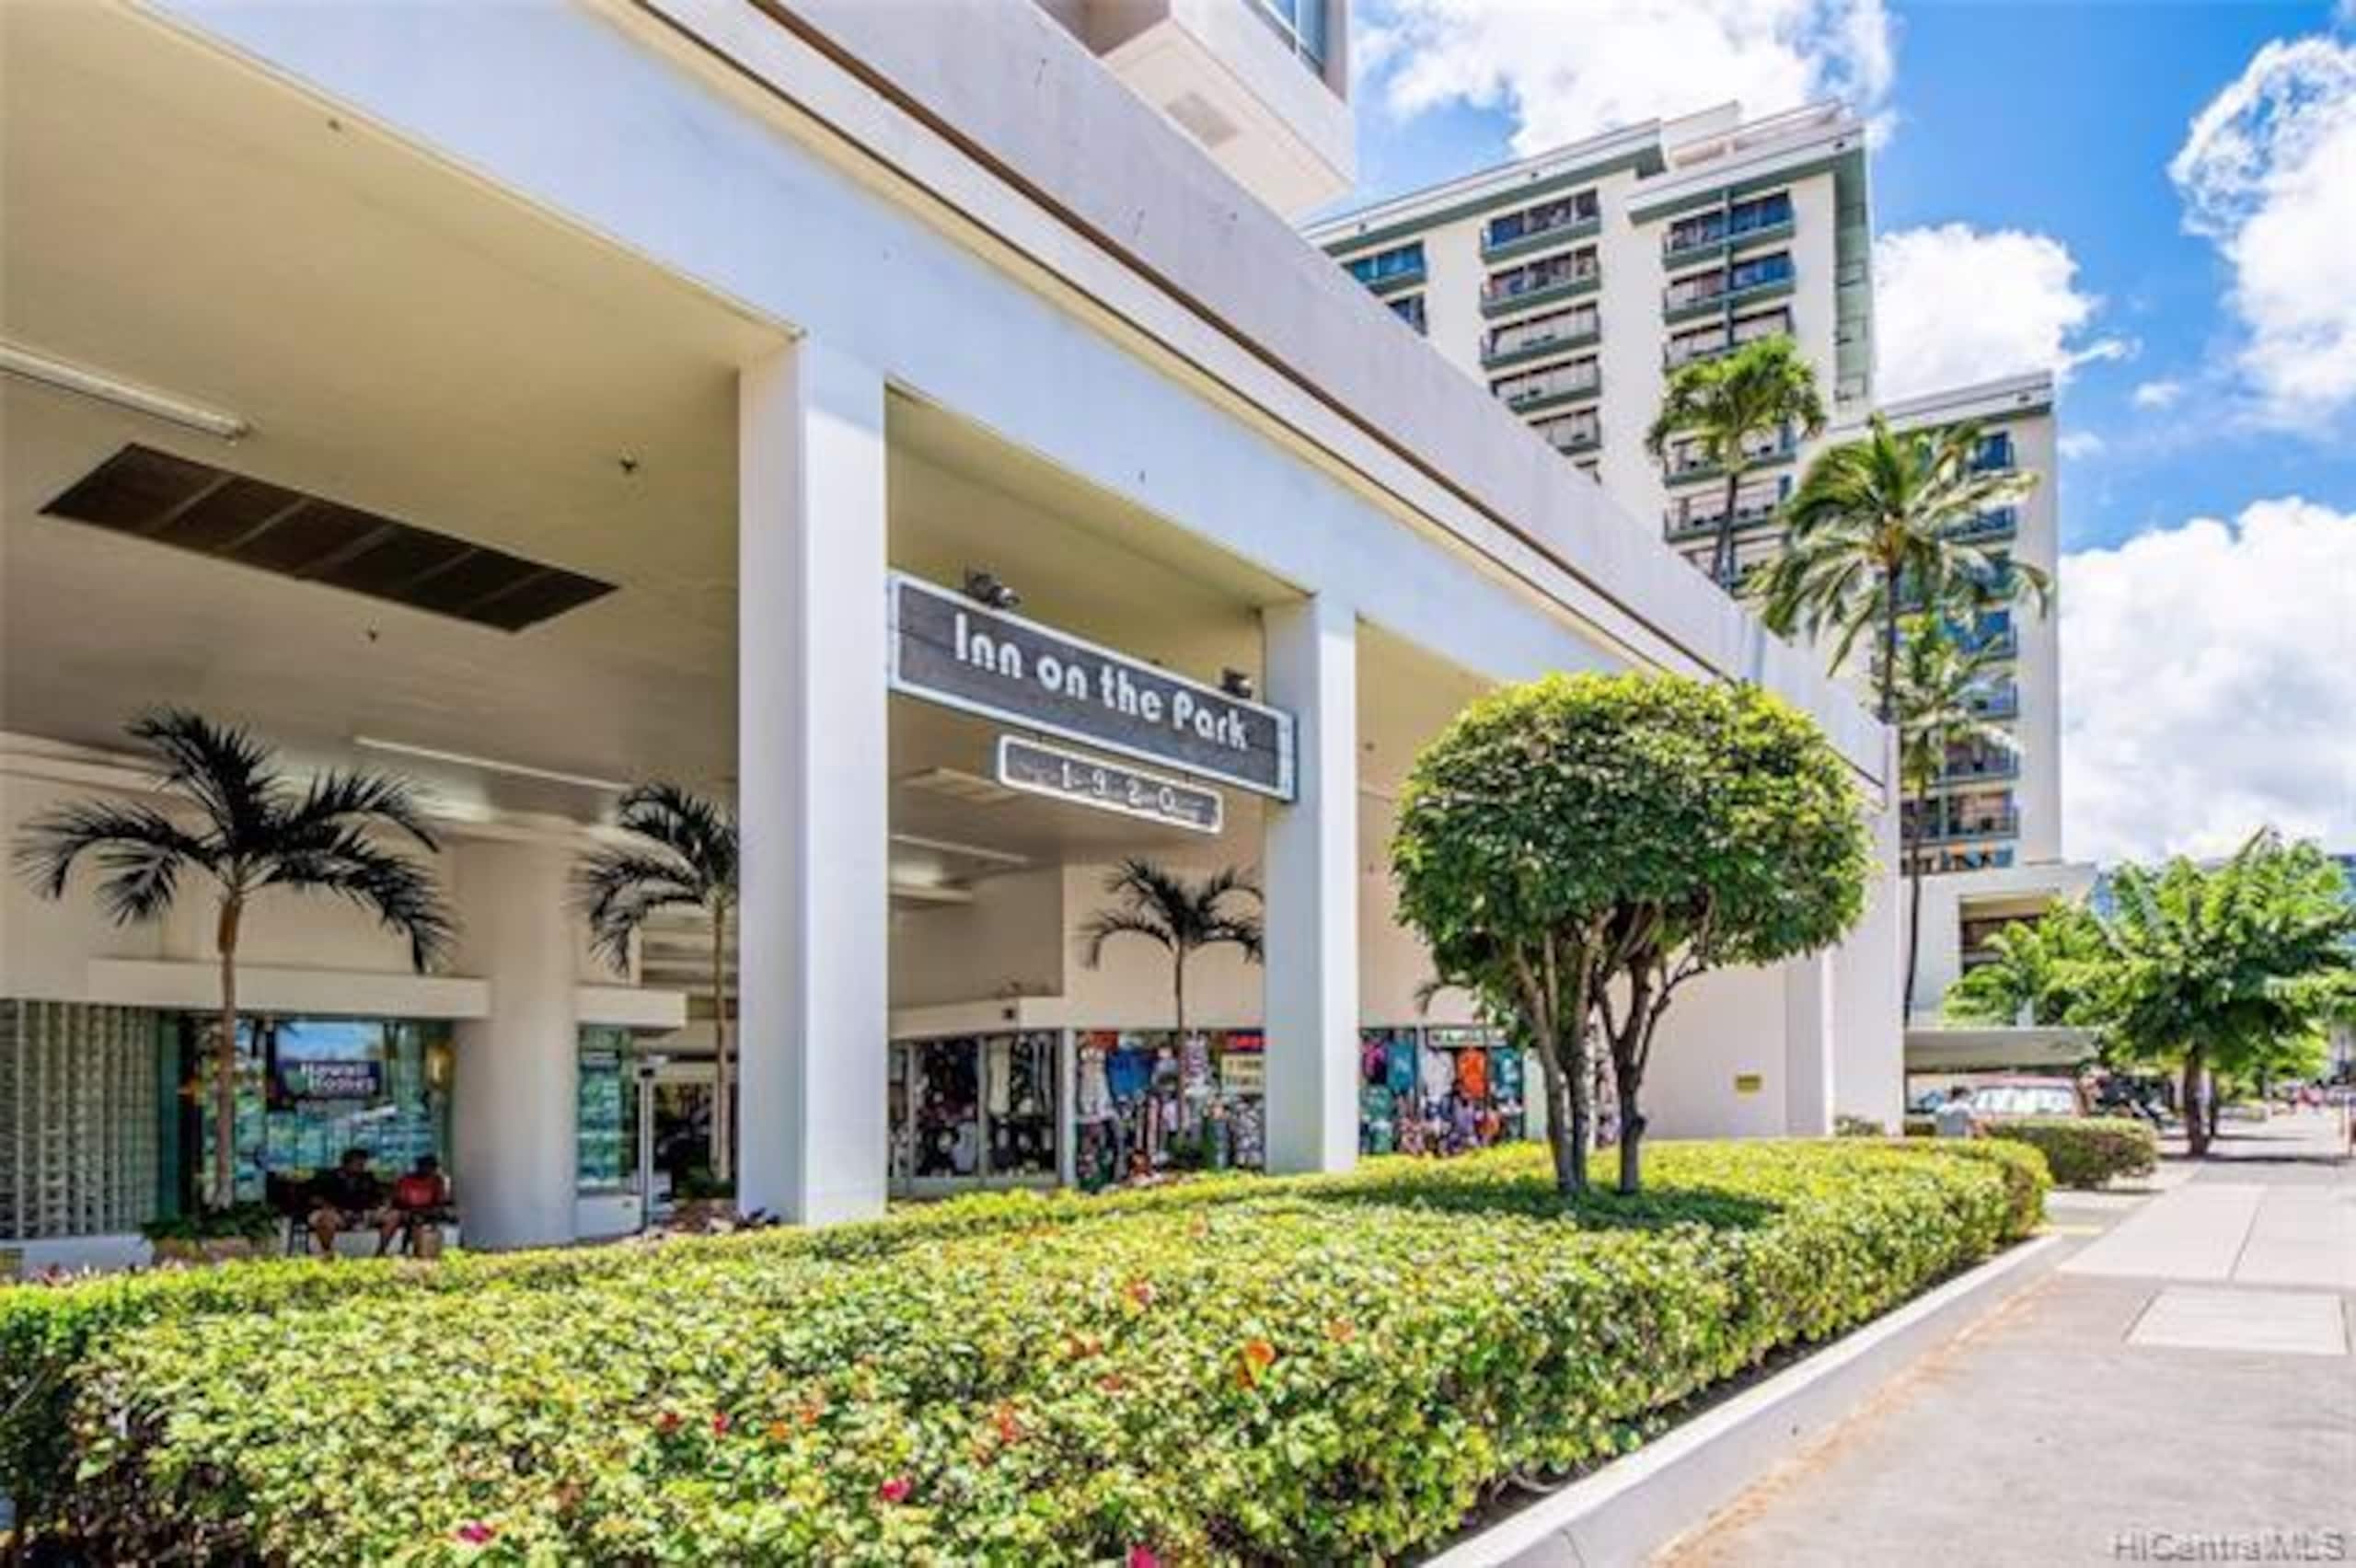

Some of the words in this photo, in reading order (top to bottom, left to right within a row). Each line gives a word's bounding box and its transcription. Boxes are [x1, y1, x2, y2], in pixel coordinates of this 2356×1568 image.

[955, 612, 1022, 679] Inn
[1036, 654, 1088, 700] on
[1100, 664, 1163, 722] the
[1172, 691, 1248, 751] Park
